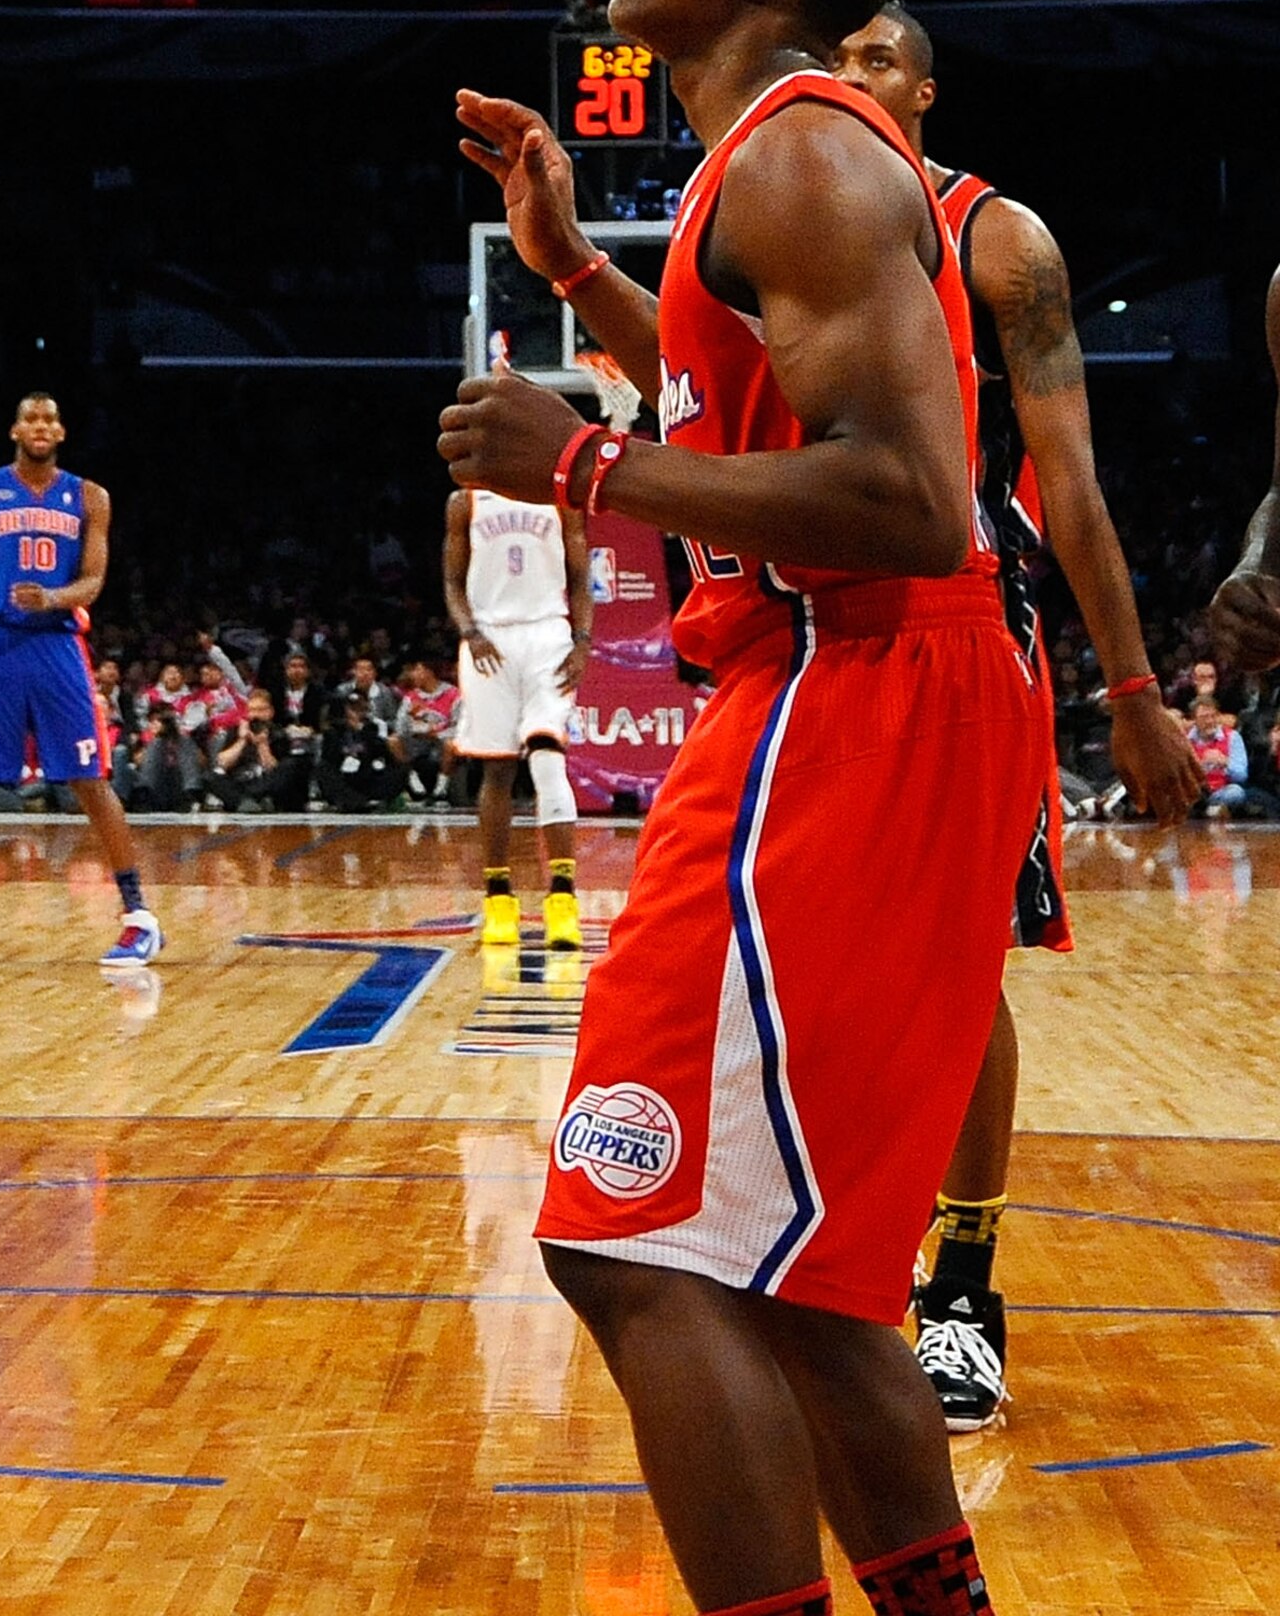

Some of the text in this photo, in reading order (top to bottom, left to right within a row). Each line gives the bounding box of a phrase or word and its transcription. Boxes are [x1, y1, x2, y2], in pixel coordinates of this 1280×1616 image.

[582, 45, 653, 79] 6:22
[575, 77, 645, 137] 20
[19, 535, 57, 573] 10
[560, 1111, 664, 1171] CLIPPERS
[594, 1117, 667, 1146] LOS ANGELES
